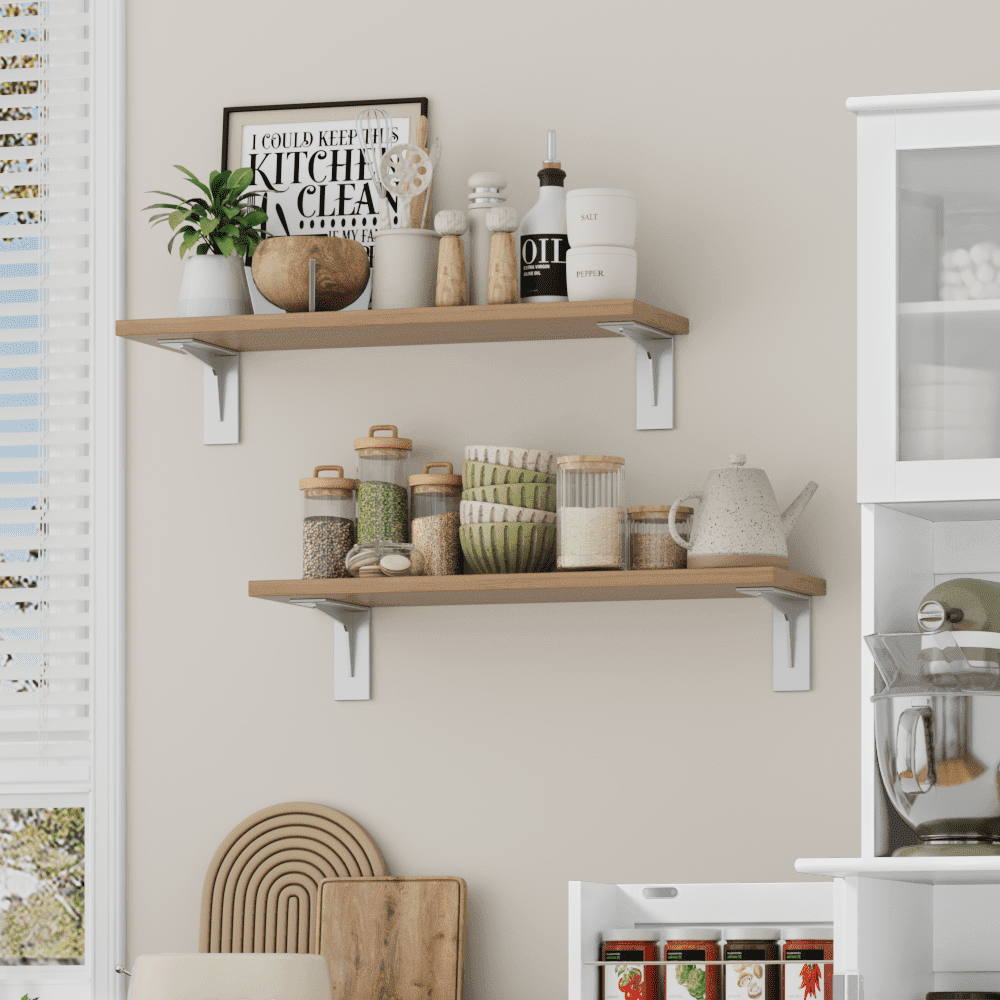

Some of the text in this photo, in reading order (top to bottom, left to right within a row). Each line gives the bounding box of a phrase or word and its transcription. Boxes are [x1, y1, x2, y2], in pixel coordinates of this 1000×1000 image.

[251, 126, 399, 150] I COULD KEEP THIS
[580, 213, 598, 221] SALT
[522, 238, 566, 265] OIL
[576, 269, 604, 278] PEPPER
